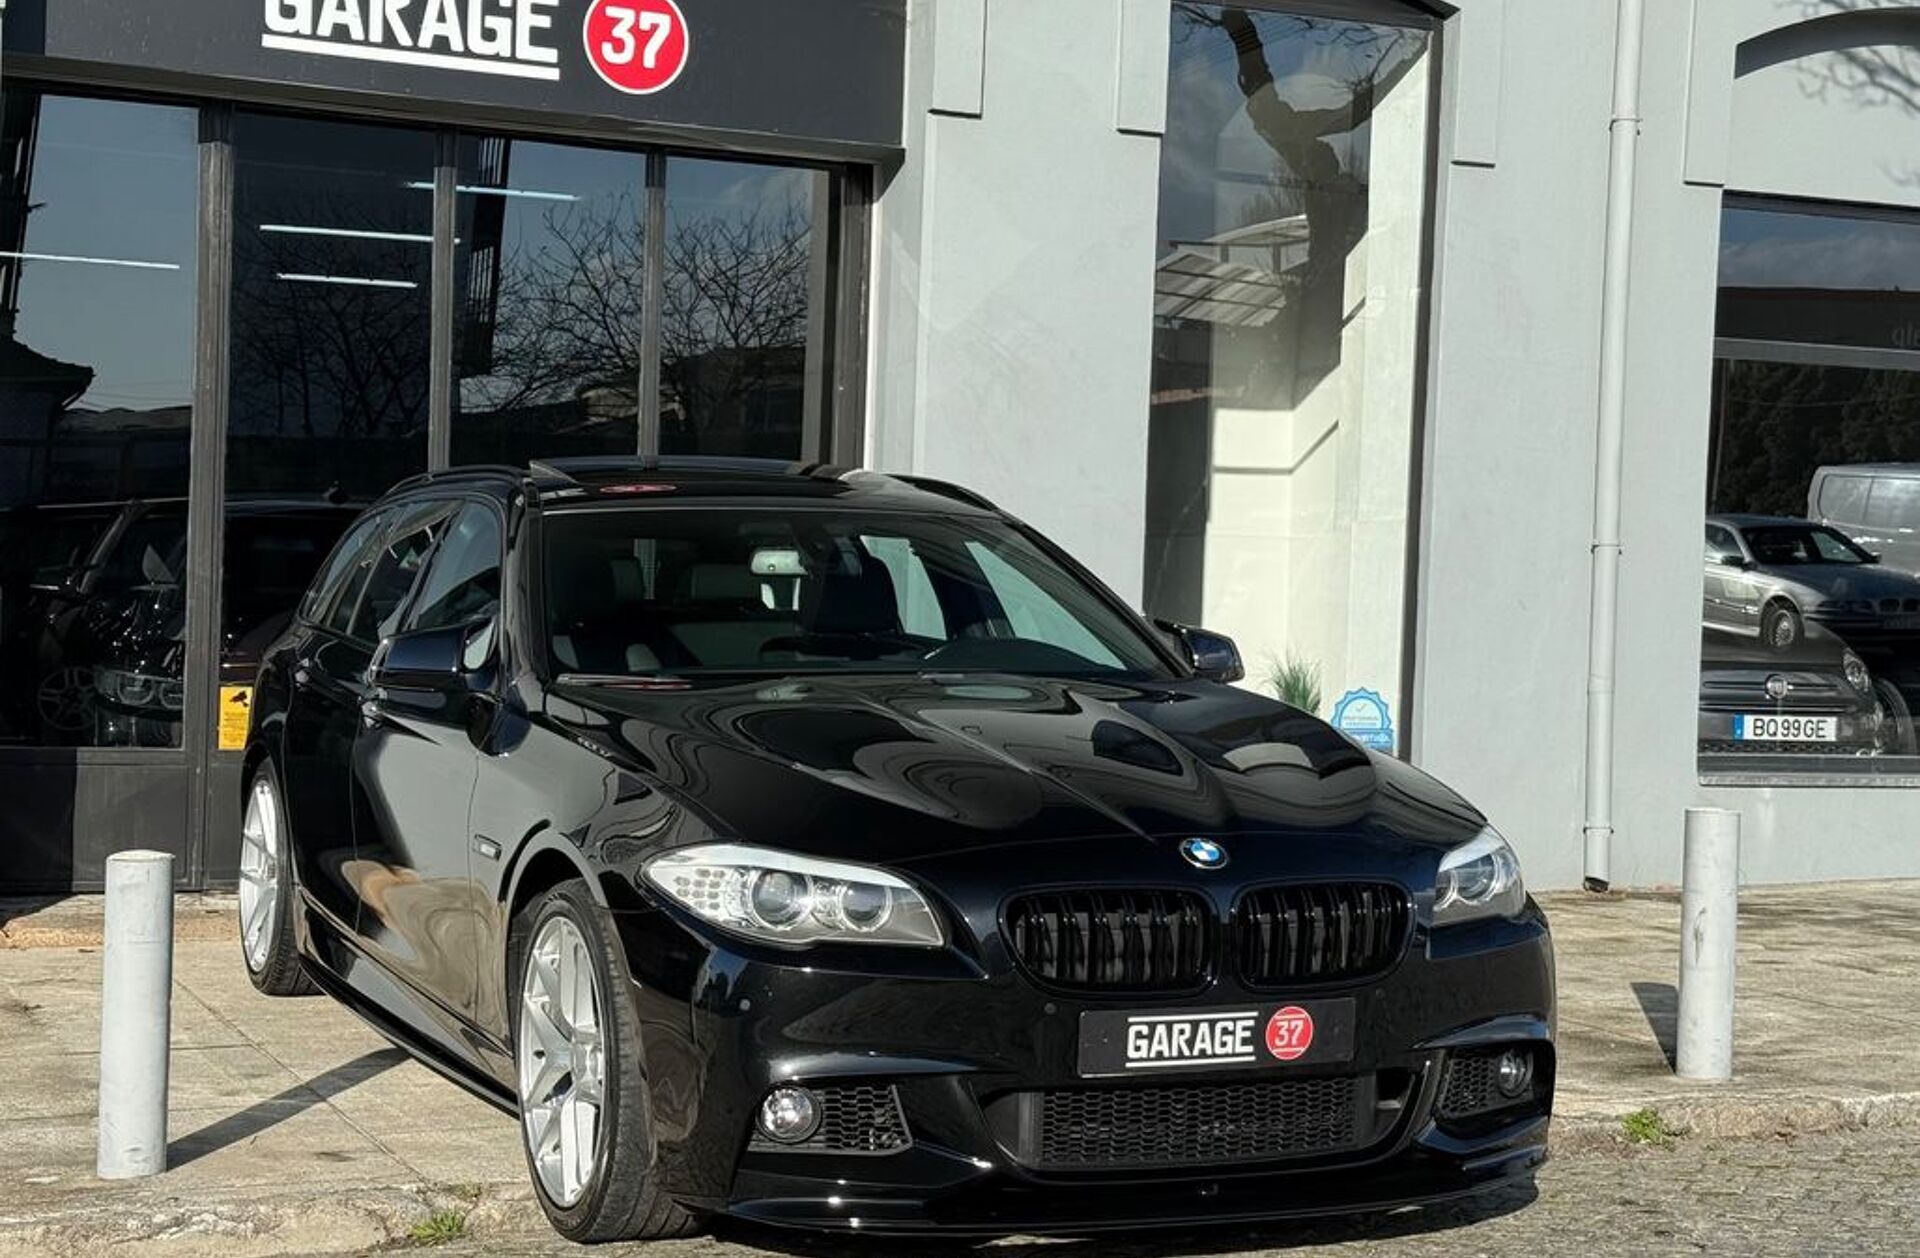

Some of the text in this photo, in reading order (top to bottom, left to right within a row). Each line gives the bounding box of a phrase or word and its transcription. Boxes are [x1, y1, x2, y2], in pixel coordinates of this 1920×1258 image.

[601, 5, 672, 69] 37
[1126, 1019, 1305, 1060] GARAGE 37
